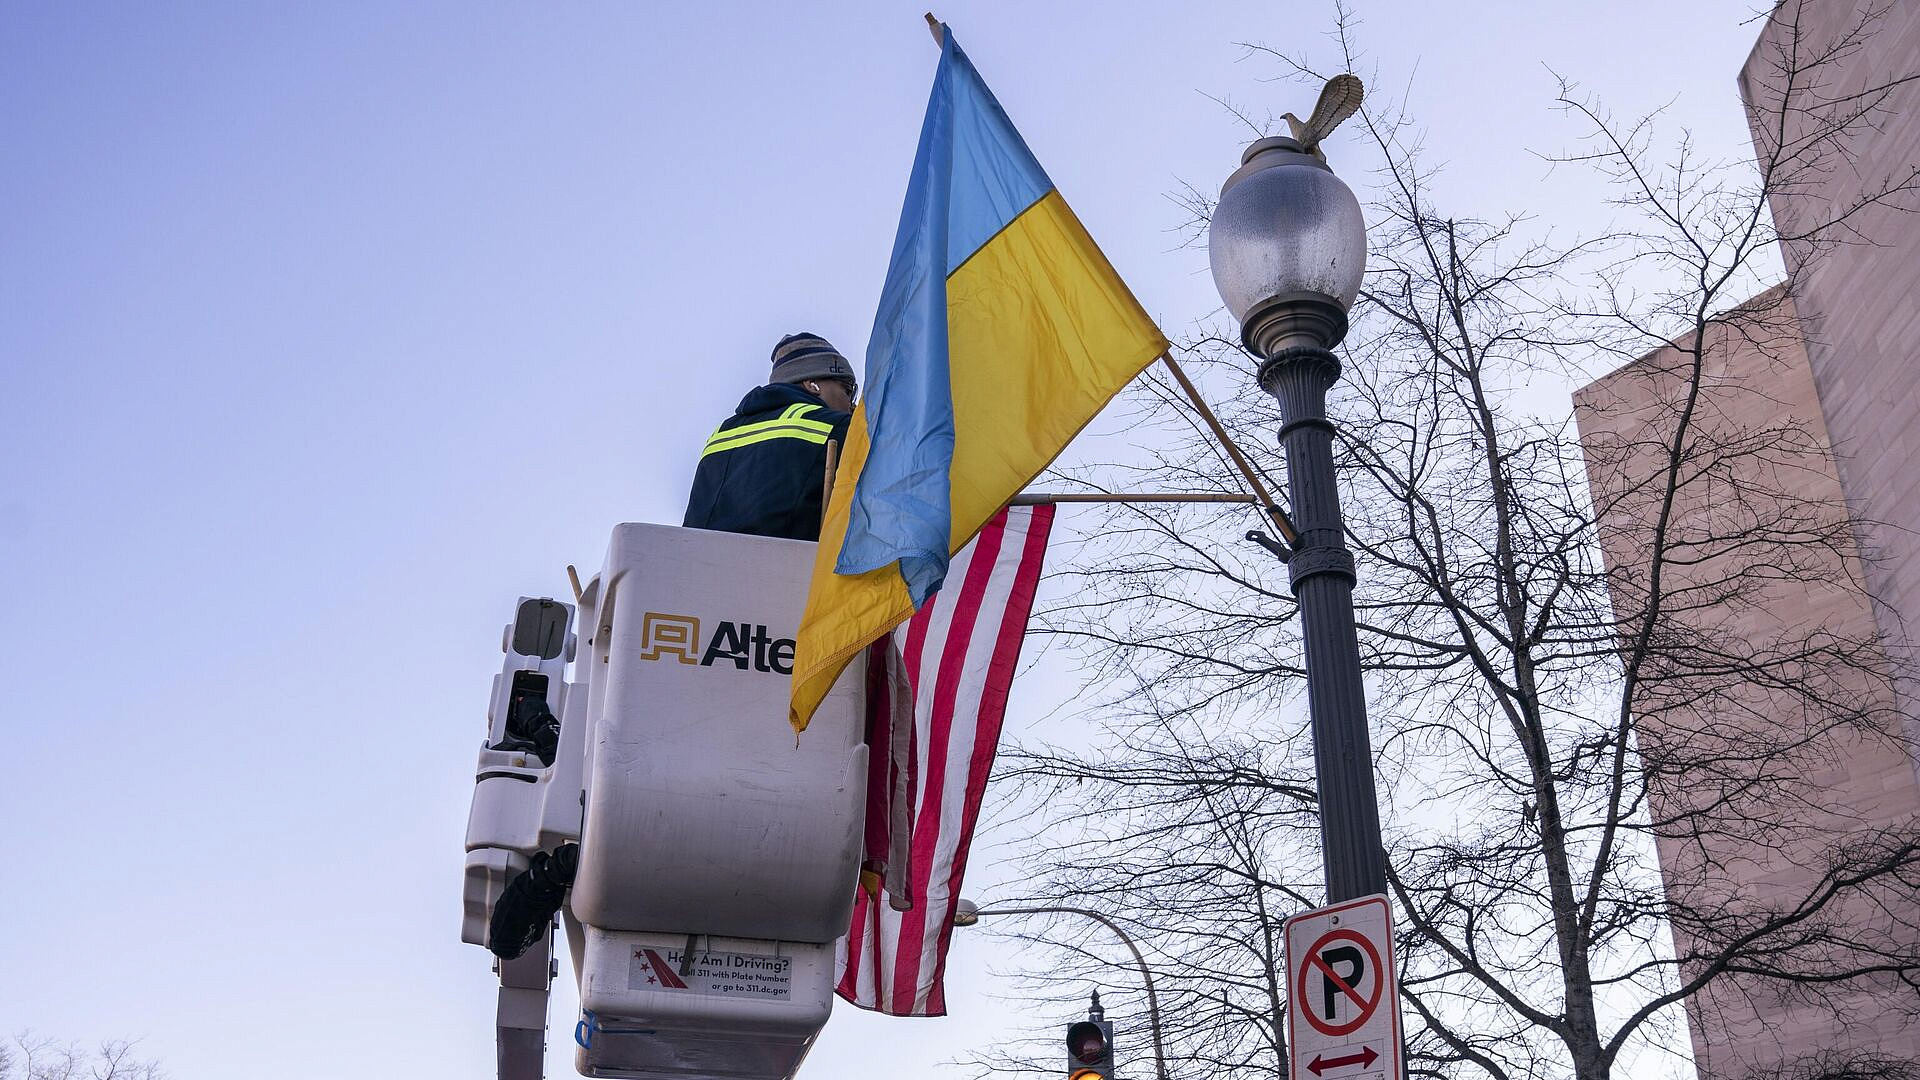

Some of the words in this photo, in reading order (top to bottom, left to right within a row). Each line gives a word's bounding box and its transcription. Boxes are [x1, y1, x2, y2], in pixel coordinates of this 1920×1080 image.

[700, 621, 796, 675] Alte
[701, 954, 722, 966] Am
[727, 955, 731, 967] I
[734, 956, 789, 973] Driving?
[697, 969, 710, 977] 311
[712, 970, 730, 978] with
[732, 971, 753, 980] Plate
[755, 974, 789, 983] Number
[1321, 946, 1364, 1020] P
[723, 984, 734, 992] go
[746, 984, 789, 996] 311.dc.gov
